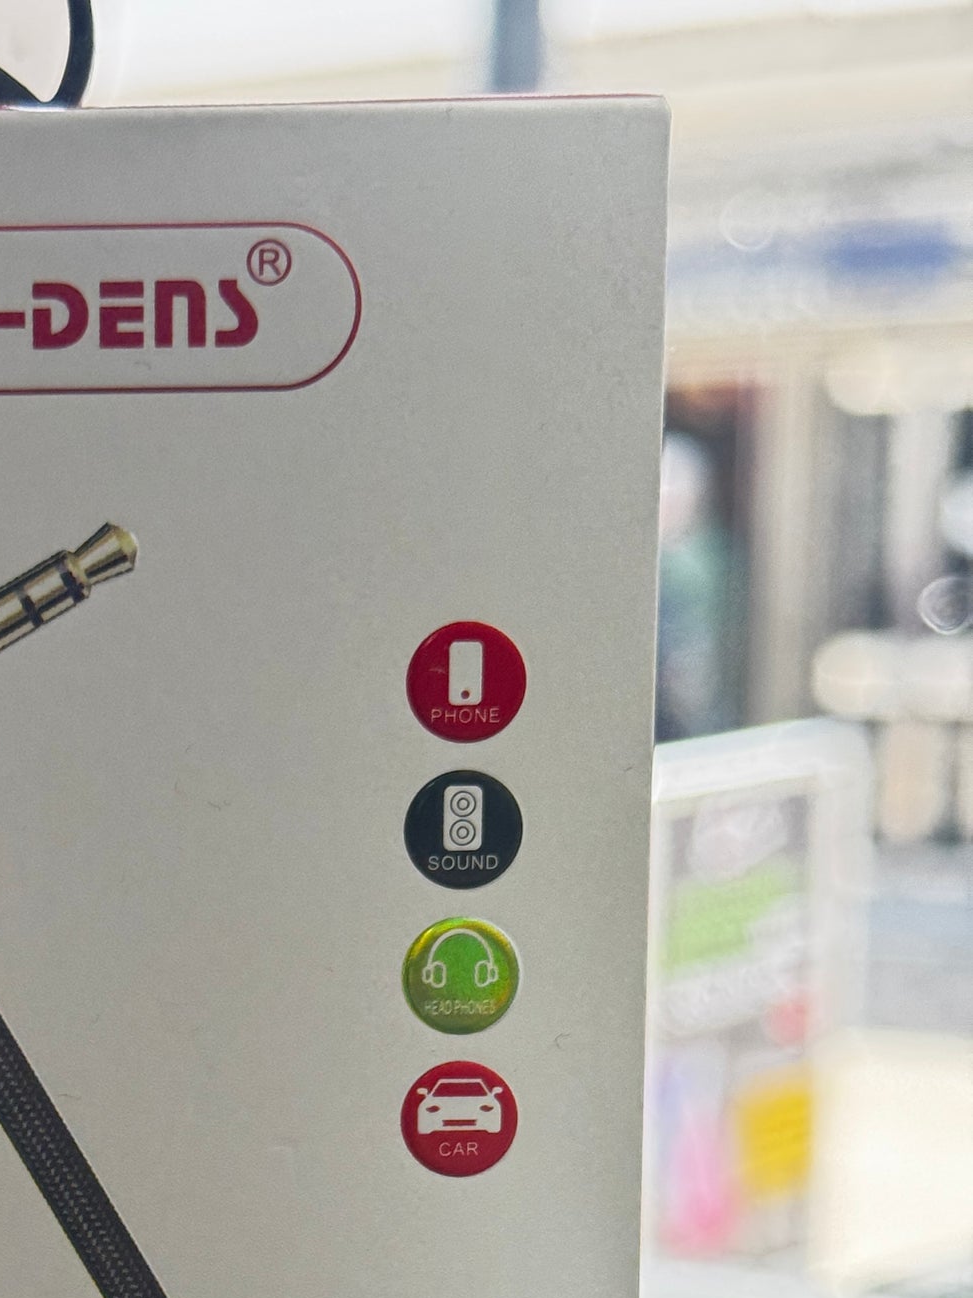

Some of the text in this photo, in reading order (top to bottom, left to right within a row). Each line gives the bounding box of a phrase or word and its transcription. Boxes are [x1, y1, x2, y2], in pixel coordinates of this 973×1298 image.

[430, 708, 501, 724] PHONE
[427, 855, 498, 871] SOUND
[438, 1142, 479, 1157] CAR
